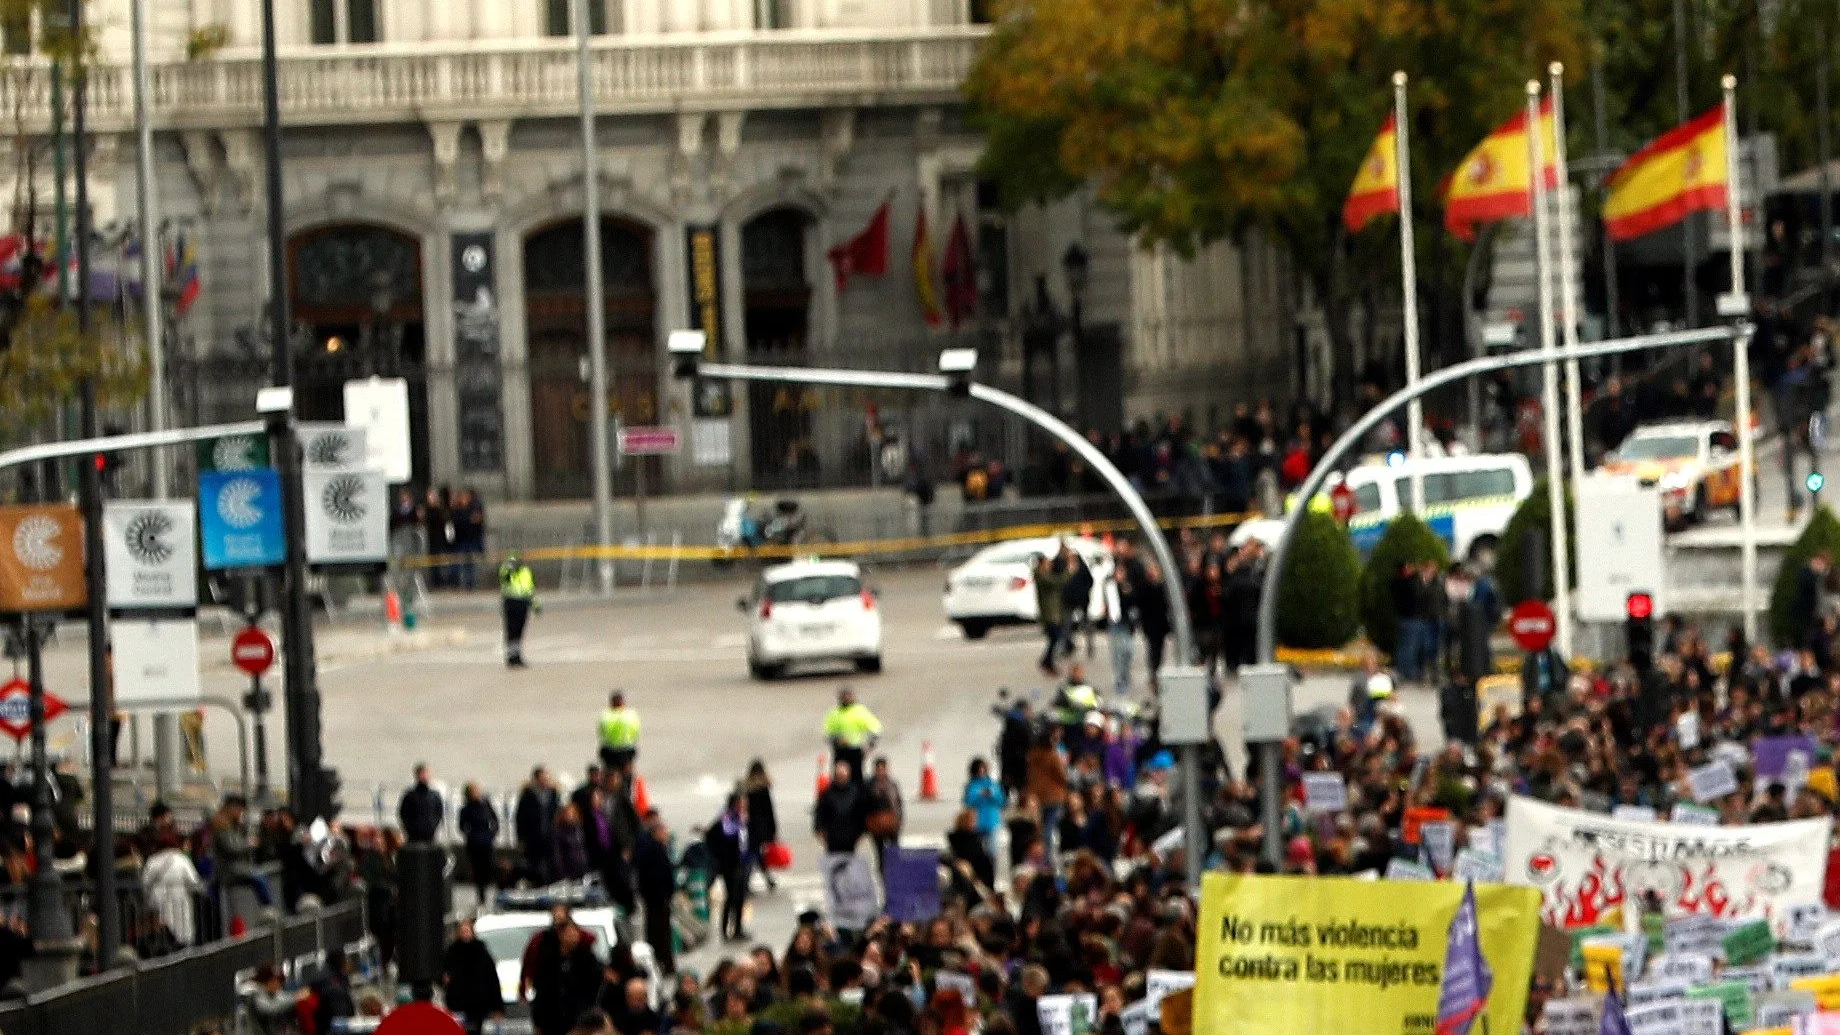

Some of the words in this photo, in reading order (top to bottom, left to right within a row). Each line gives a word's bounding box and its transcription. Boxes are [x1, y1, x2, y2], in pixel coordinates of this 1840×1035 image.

[1221, 917, 1251, 943] No
[1260, 918, 1311, 946] más
[1318, 917, 1418, 949] violencia
[1220, 954, 1298, 980] contra
[1304, 952, 1338, 980] las
[1344, 955, 1440, 987] mujeres
